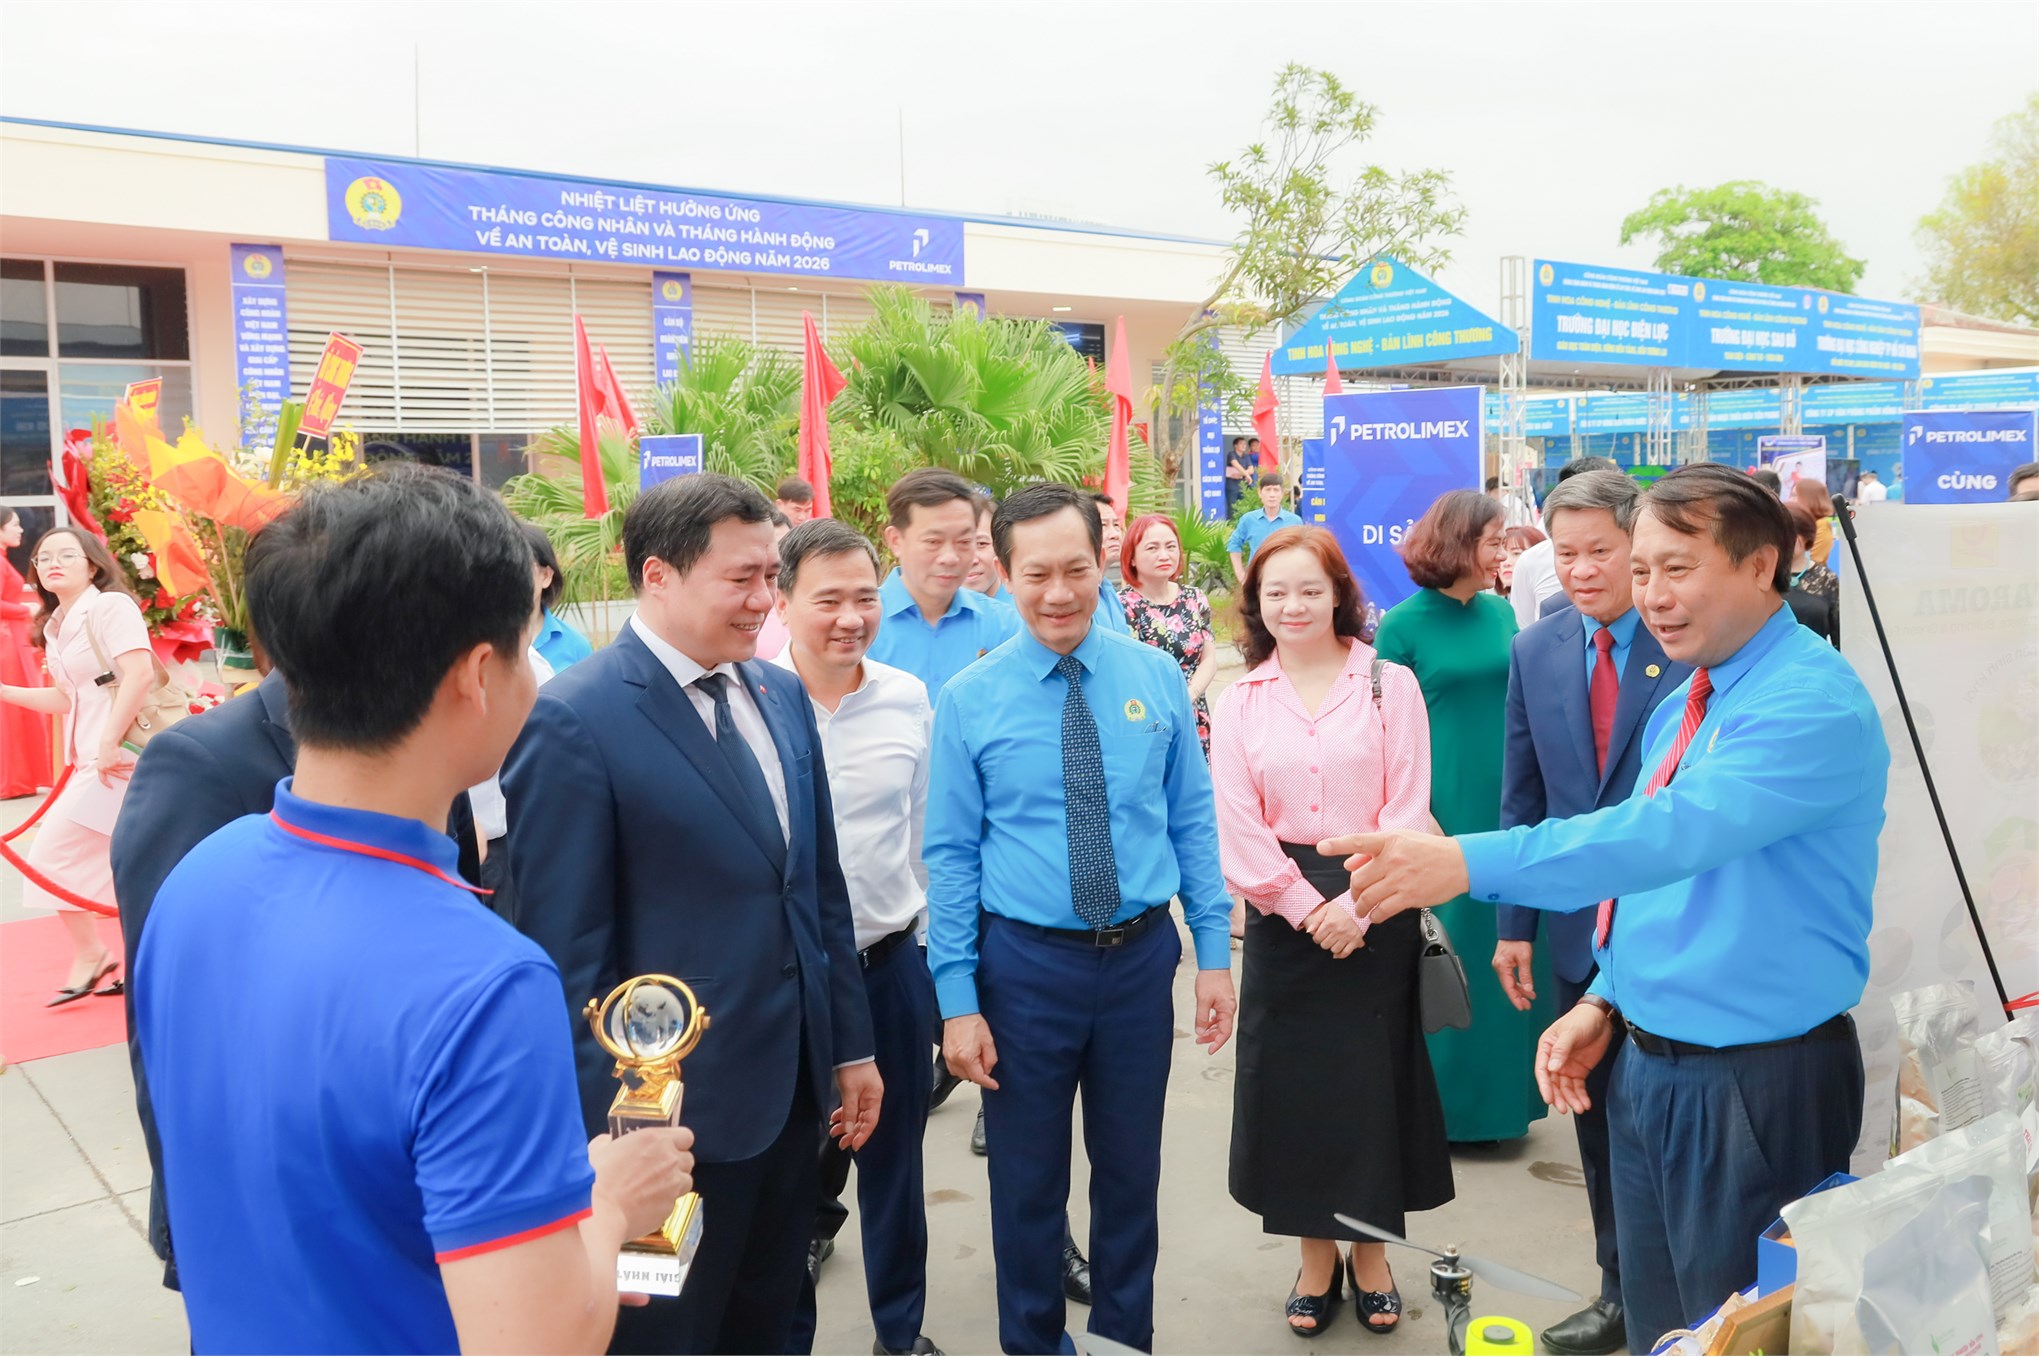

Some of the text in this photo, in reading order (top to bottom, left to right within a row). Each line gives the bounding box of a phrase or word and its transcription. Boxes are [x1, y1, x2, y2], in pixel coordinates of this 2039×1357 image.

[561, 190, 761, 223] NHIỆT LIỆT HƯỞNG ỨNG
[468, 204, 835, 252] THÁNG CÔNG NHÂN VÀ THÁNG HÀNH ĐỘNG
[476, 226, 830, 270] VỀ AN TOÀN, VỆ SINH LAO ĐỘNG NĂM 2026
[889, 260, 951, 275] PETROLIMEX
[1557, 312, 1594, 334] TRƯỜNG
[1287, 347, 1306, 361] TINH
[1308, 345, 1324, 359] HOA
[1426, 328, 1452, 347] CÔNG
[1454, 326, 1492, 344] THƯƠNG
[1350, 420, 1469, 440] PETROLIMEX
[1926, 429, 2027, 444] PETROLIMEX
[651, 455, 697, 467] PETROLIMEX
[1363, 524, 1384, 545] DI
